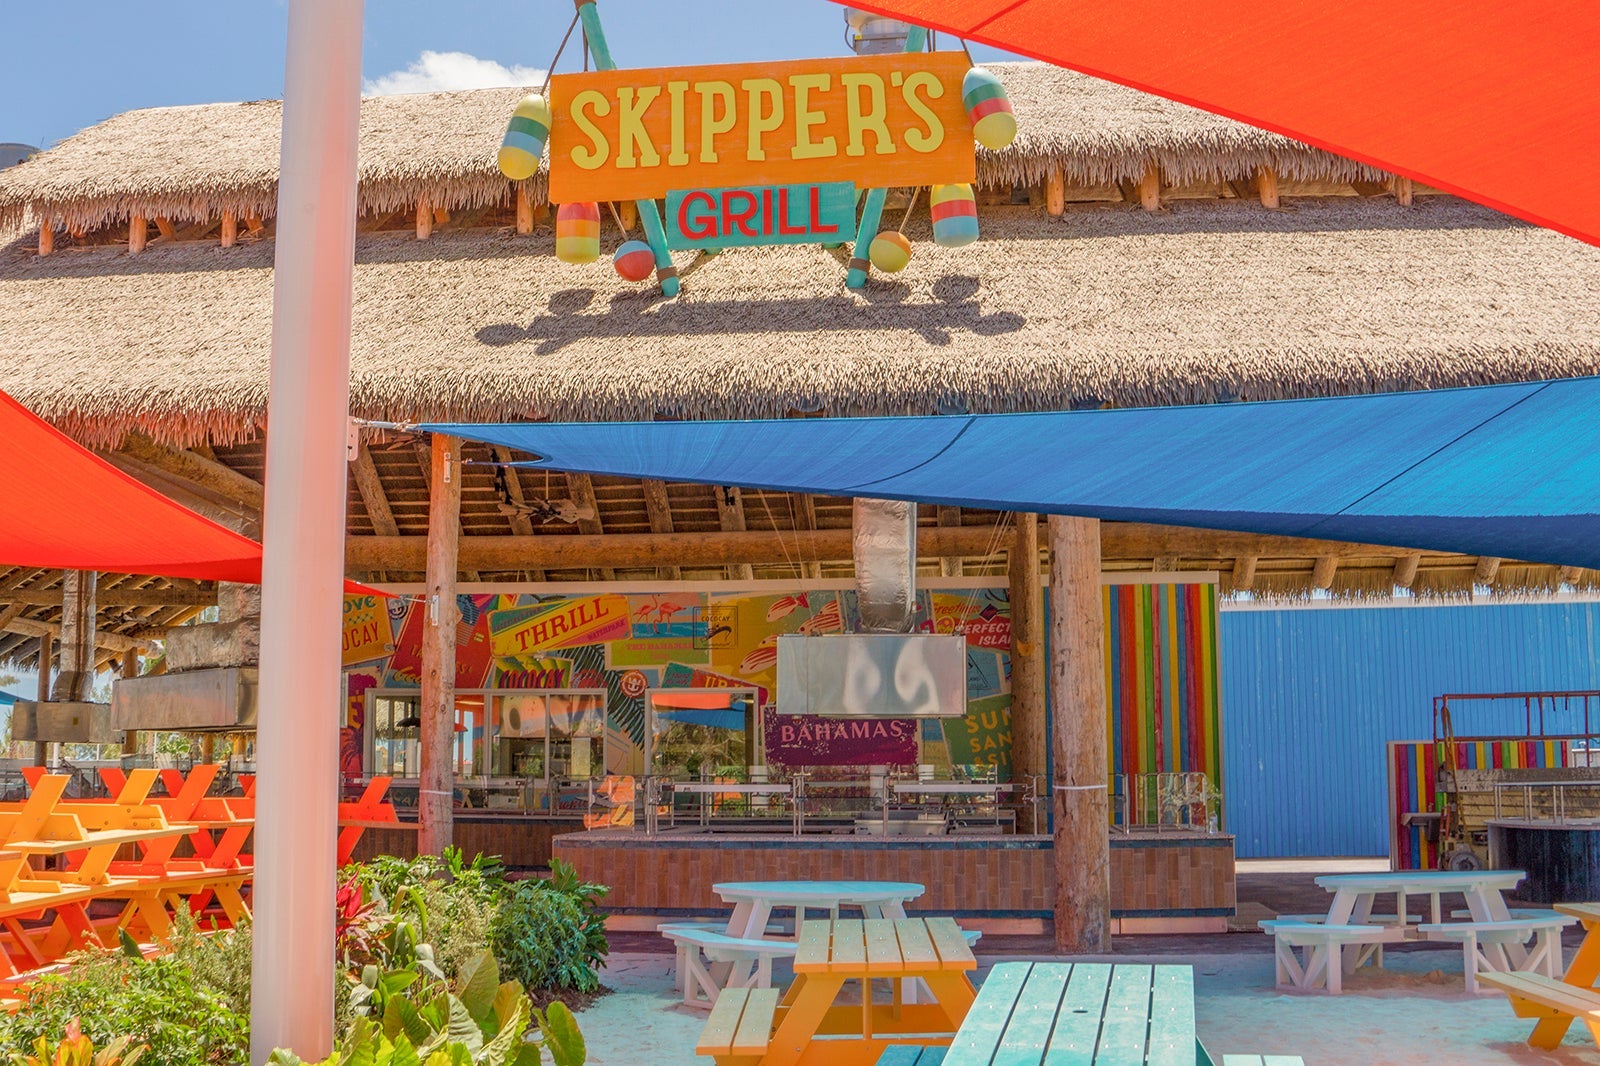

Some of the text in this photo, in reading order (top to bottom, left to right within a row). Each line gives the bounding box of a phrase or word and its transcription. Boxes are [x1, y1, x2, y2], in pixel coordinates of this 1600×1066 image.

[569, 71, 945, 170] SKIPPER'S
[677, 186, 839, 241] GRILL
[343, 595, 376, 613] ove
[515, 597, 609, 651] THRILL
[343, 620, 380, 652] OCAY
[978, 634, 1010, 647] ISLA
[499, 668, 566, 689] COCOCAY
[781, 720, 903, 743] BAHAMAS
[969, 730, 1013, 753] SAN
